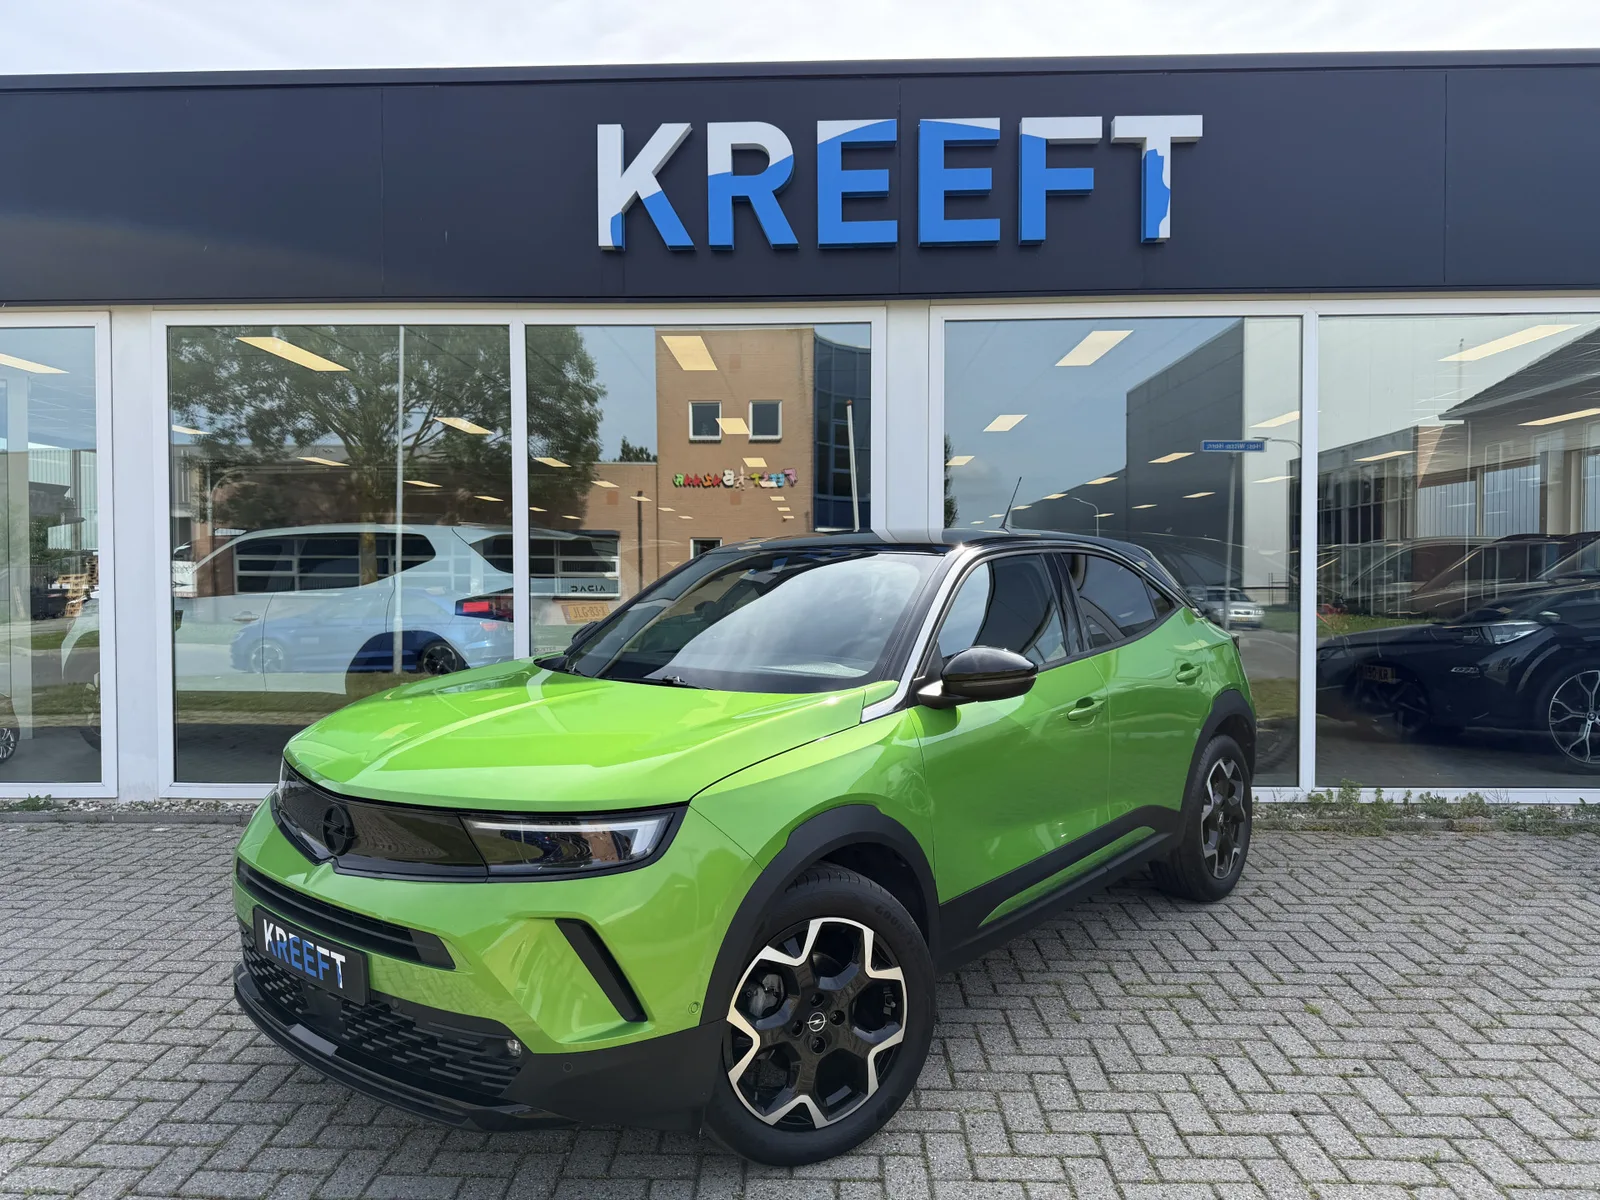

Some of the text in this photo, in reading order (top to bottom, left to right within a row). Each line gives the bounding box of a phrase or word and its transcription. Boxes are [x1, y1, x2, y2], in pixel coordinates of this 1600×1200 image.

[596, 114, 1204, 251] KREEFT
[570, 584, 606, 592] DACIA
[263, 919, 346, 989] KREEFT
